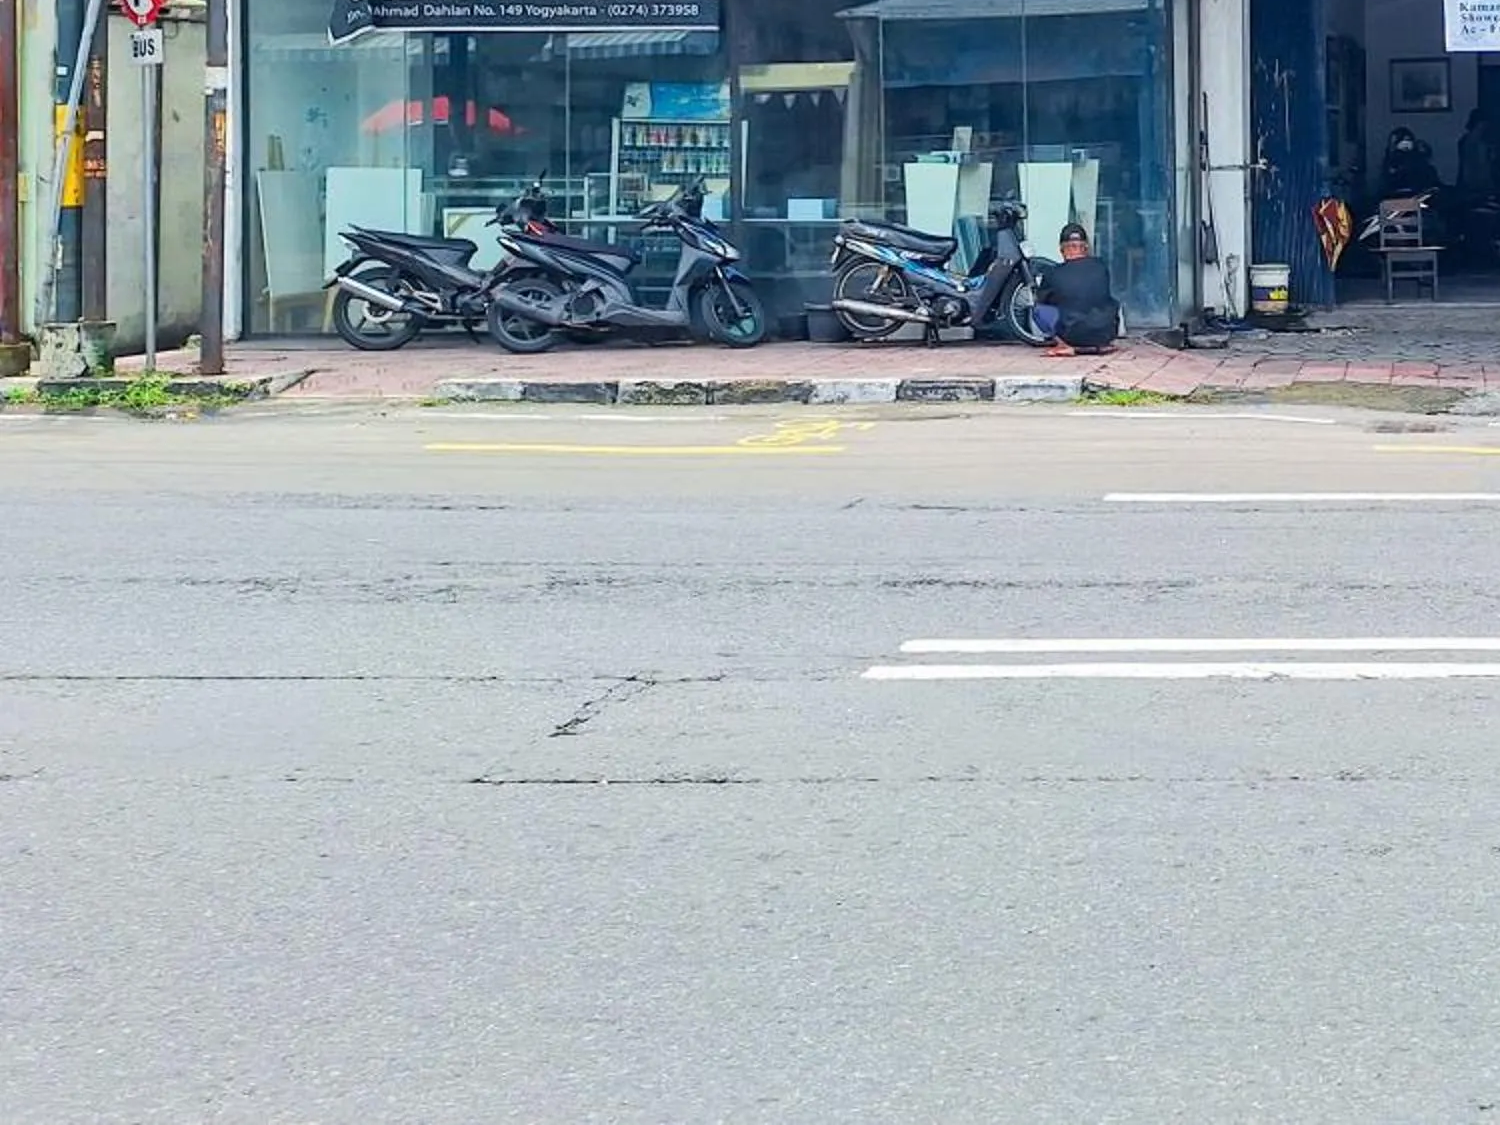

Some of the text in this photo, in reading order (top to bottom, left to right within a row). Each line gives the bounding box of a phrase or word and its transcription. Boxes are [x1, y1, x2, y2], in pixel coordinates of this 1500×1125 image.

[373, 4, 419, 16] Ahmad
[424, 4, 470, 16] Dahlan
[473, 4, 496, 16] No.
[499, 4, 523, 16] 149
[525, 3, 597, 18] Yogyakarta
[608, 4, 649, 17] (0274)
[650, 4, 699, 16] 373958
